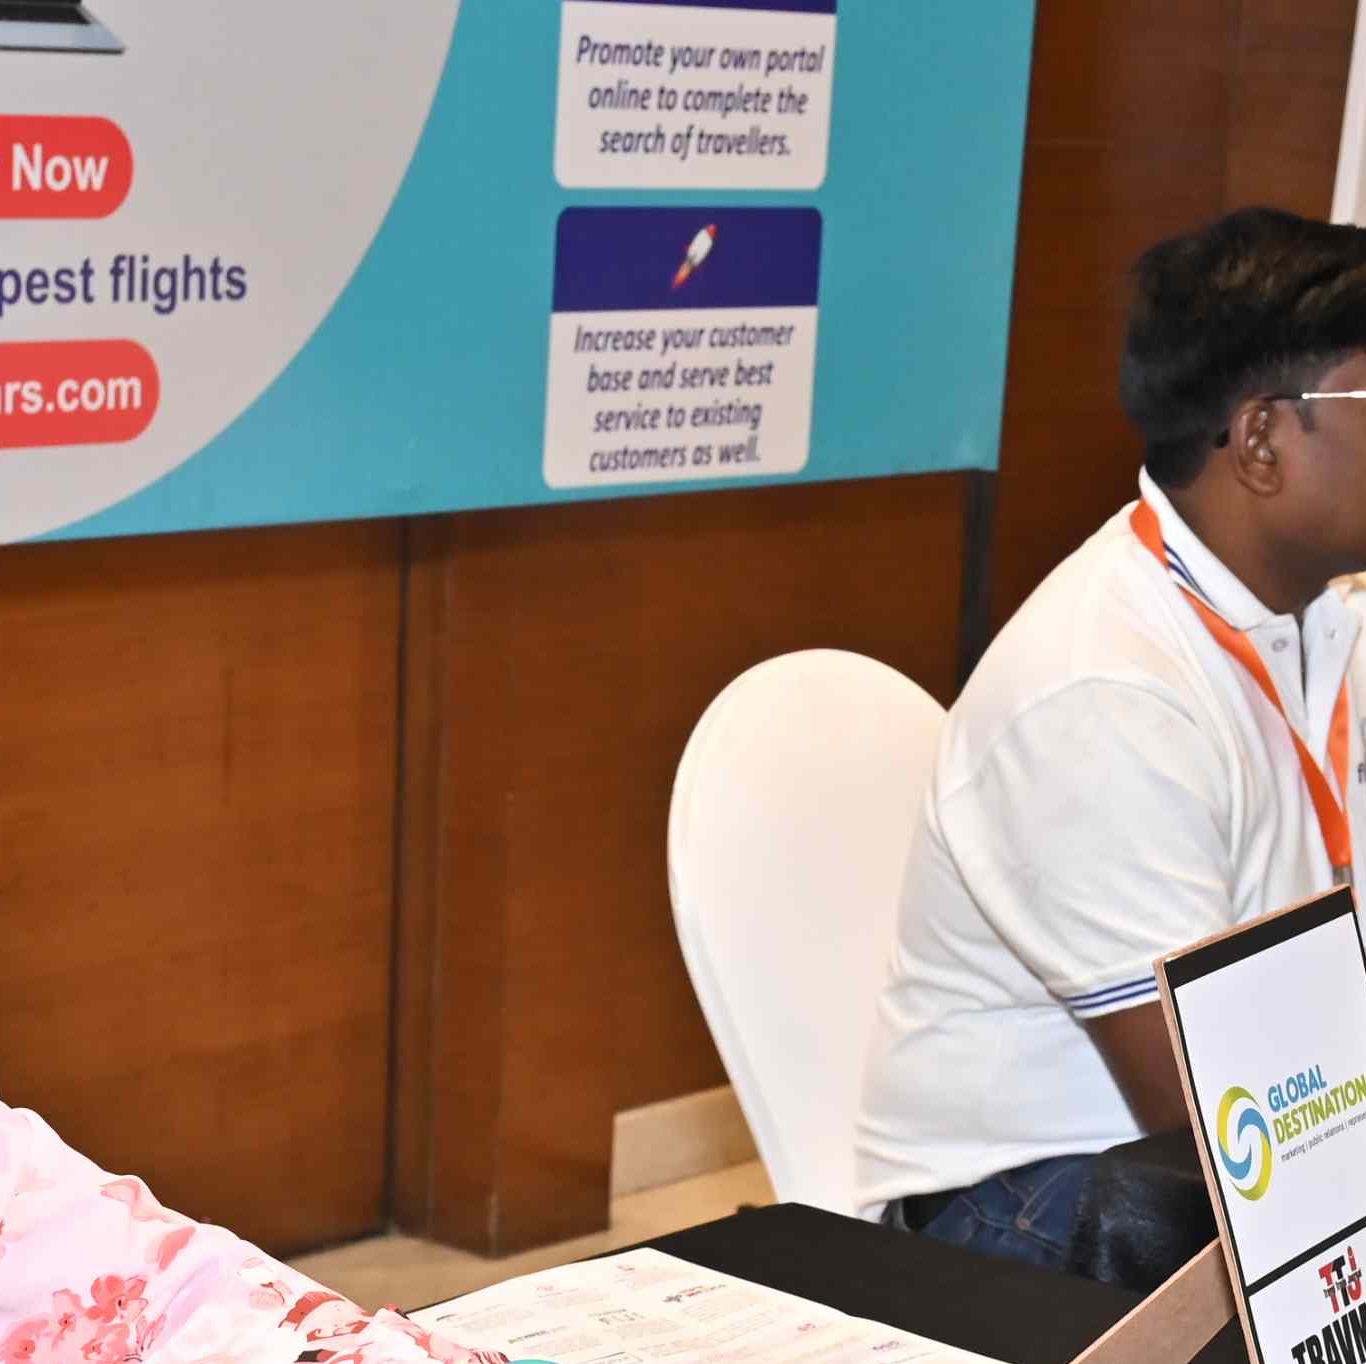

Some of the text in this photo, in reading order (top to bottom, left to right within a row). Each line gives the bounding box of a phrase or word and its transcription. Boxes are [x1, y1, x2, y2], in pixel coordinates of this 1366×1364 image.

[576, 34, 825, 78] Promote your own portal
[588, 79, 809, 118] online to complete the
[600, 124, 791, 162] search of travellers.
[12, 143, 108, 192] Now
[110, 253, 247, 315] flights
[574, 321, 795, 356] Increase your customer
[587, 357, 774, 393] base and serve best
[593, 398, 763, 433] service to existing
[589, 435, 760, 473] customers as well.
[1268, 1064, 1327, 1113] GLOBAL
